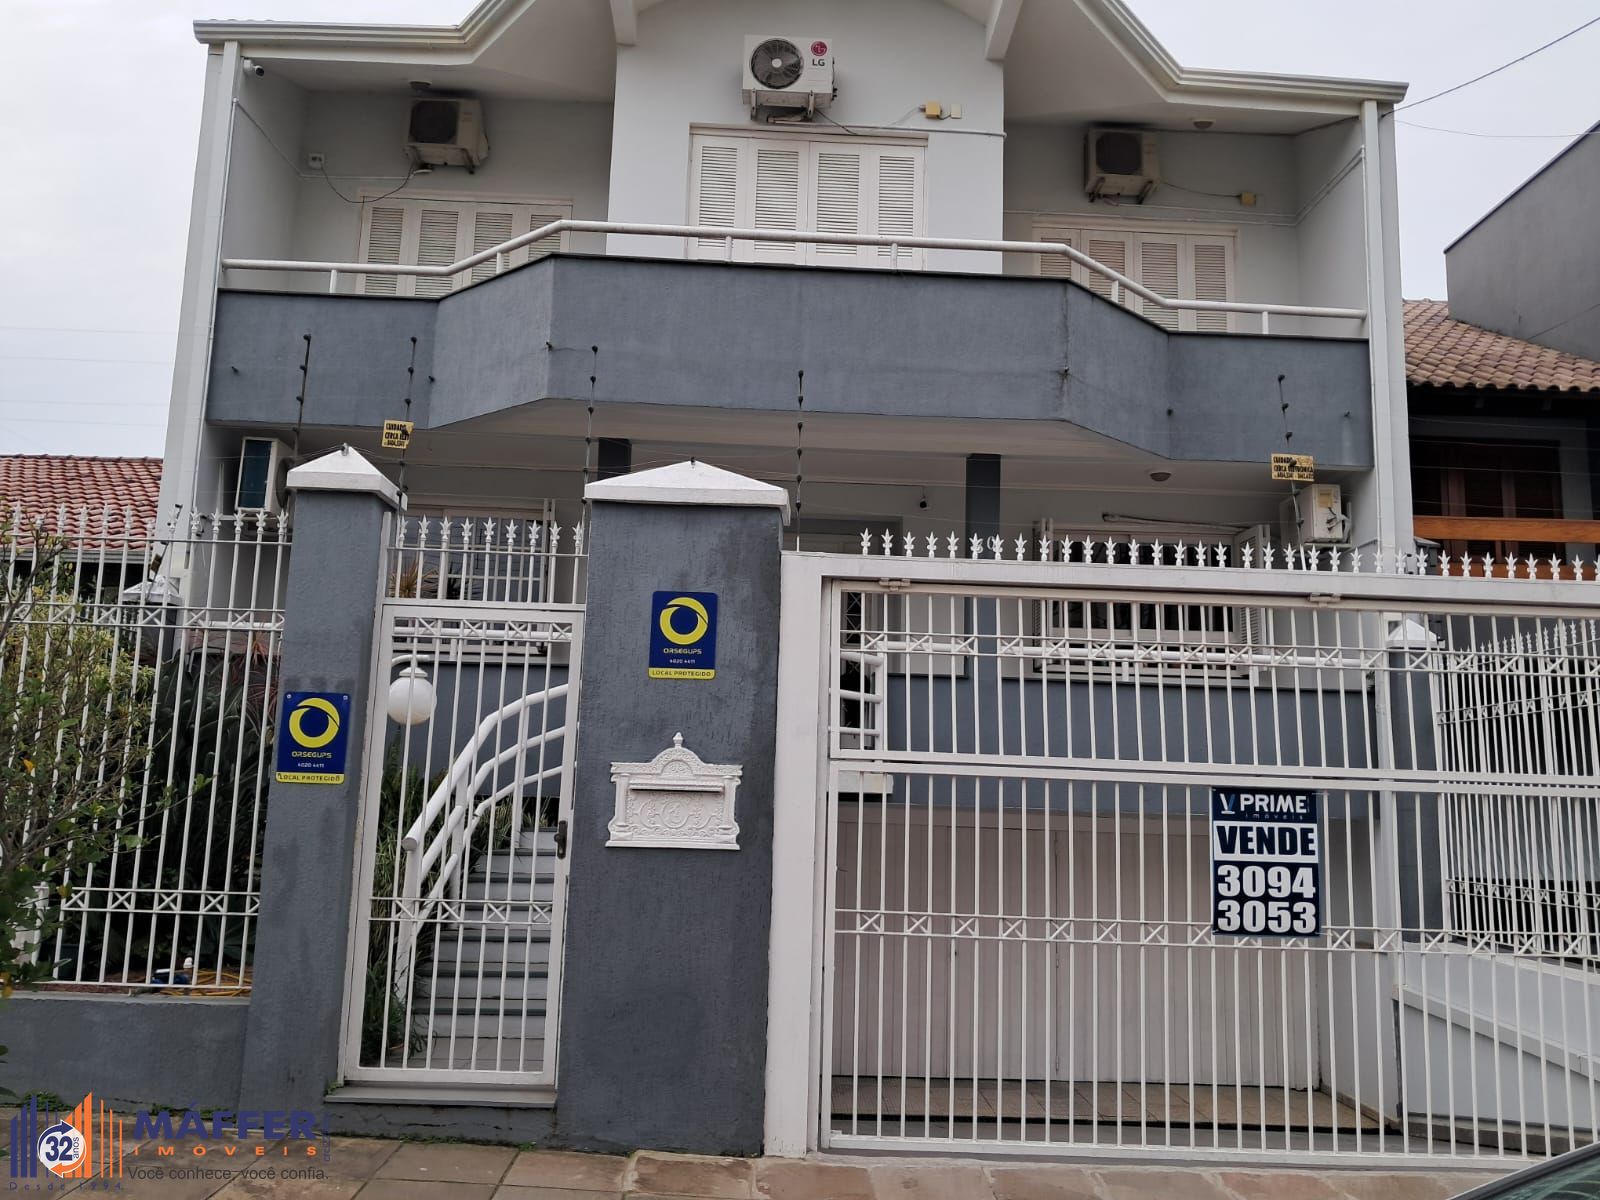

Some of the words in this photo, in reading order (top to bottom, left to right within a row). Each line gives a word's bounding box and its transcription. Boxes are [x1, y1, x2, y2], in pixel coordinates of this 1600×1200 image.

[663, 647, 702, 655] ORSEGUPS
[291, 751, 332, 759] ORSEGUPS
[1240, 793, 1307, 813] PRIME
[1216, 825, 1316, 856] VENDE
[1217, 864, 1316, 898] 3094
[1217, 899, 1316, 934] 3053
